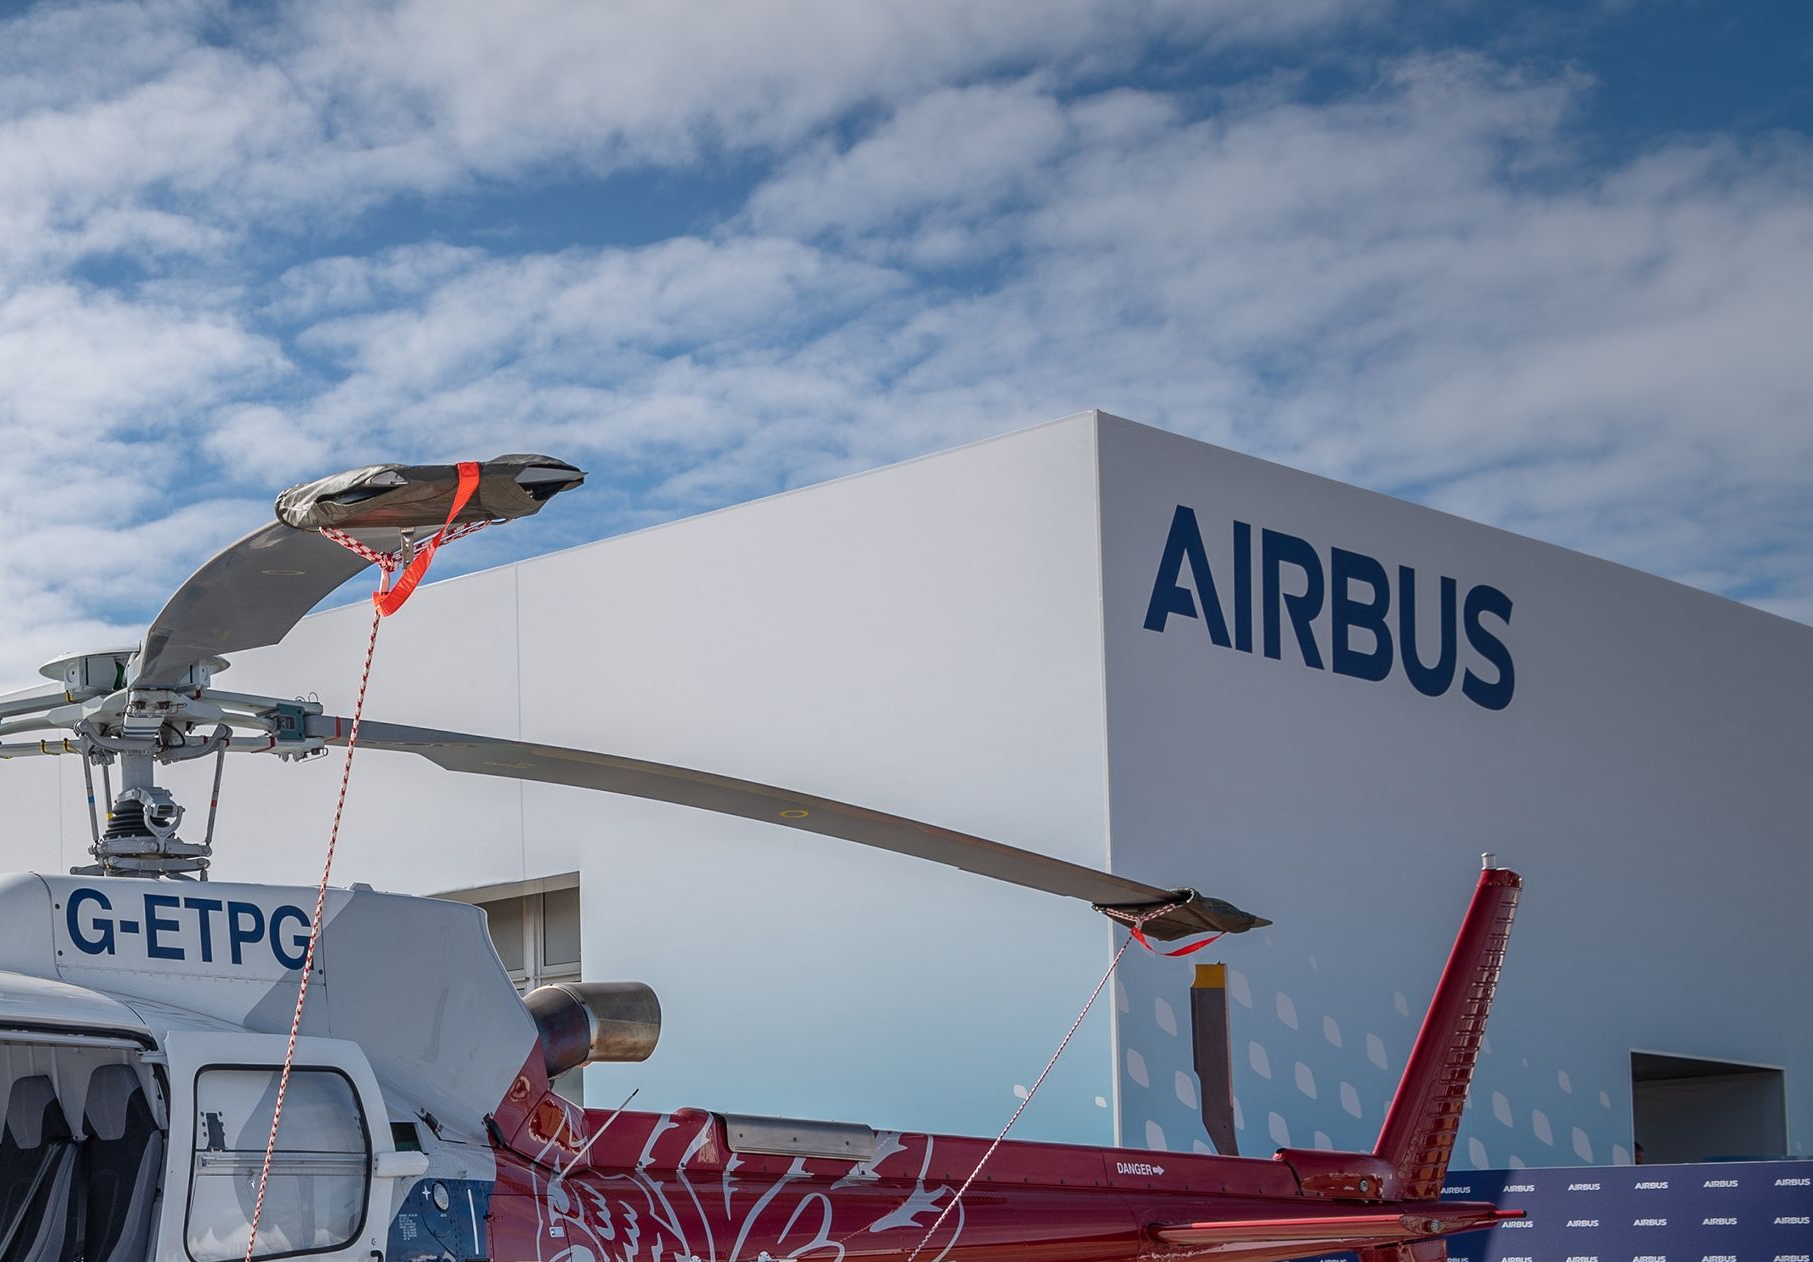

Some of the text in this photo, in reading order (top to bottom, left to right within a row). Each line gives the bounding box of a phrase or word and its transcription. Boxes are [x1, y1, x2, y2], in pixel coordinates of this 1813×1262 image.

[1143, 504, 1516, 711] AIRBUS
[65, 887, 313, 971] G-ETPG
[1117, 1162, 1153, 1175] DANGER
[1634, 1181, 1668, 1189] AIRBUS
[1702, 1179, 1738, 1187] AIRBUS
[1773, 1178, 1810, 1186] AIRBUS
[1502, 1184, 1535, 1192] AIRBUS
[1567, 1183, 1600, 1191] AIRBUS
[1501, 1220, 1533, 1228] AIRBUS
[1565, 1219, 1599, 1227] AIRBUS
[1632, 1218, 1667, 1226] AIRBUS
[1701, 1217, 1737, 1225] AIRBUS
[1773, 1216, 1810, 1224] AIRBUS
[1564, 1255, 1598, 1262] AIRBUS
[1631, 1255, 1666, 1262] AIRBUS
[1700, 1254, 1737, 1262] AIRBUS
[1772, 1254, 1810, 1262] AIRBUS
